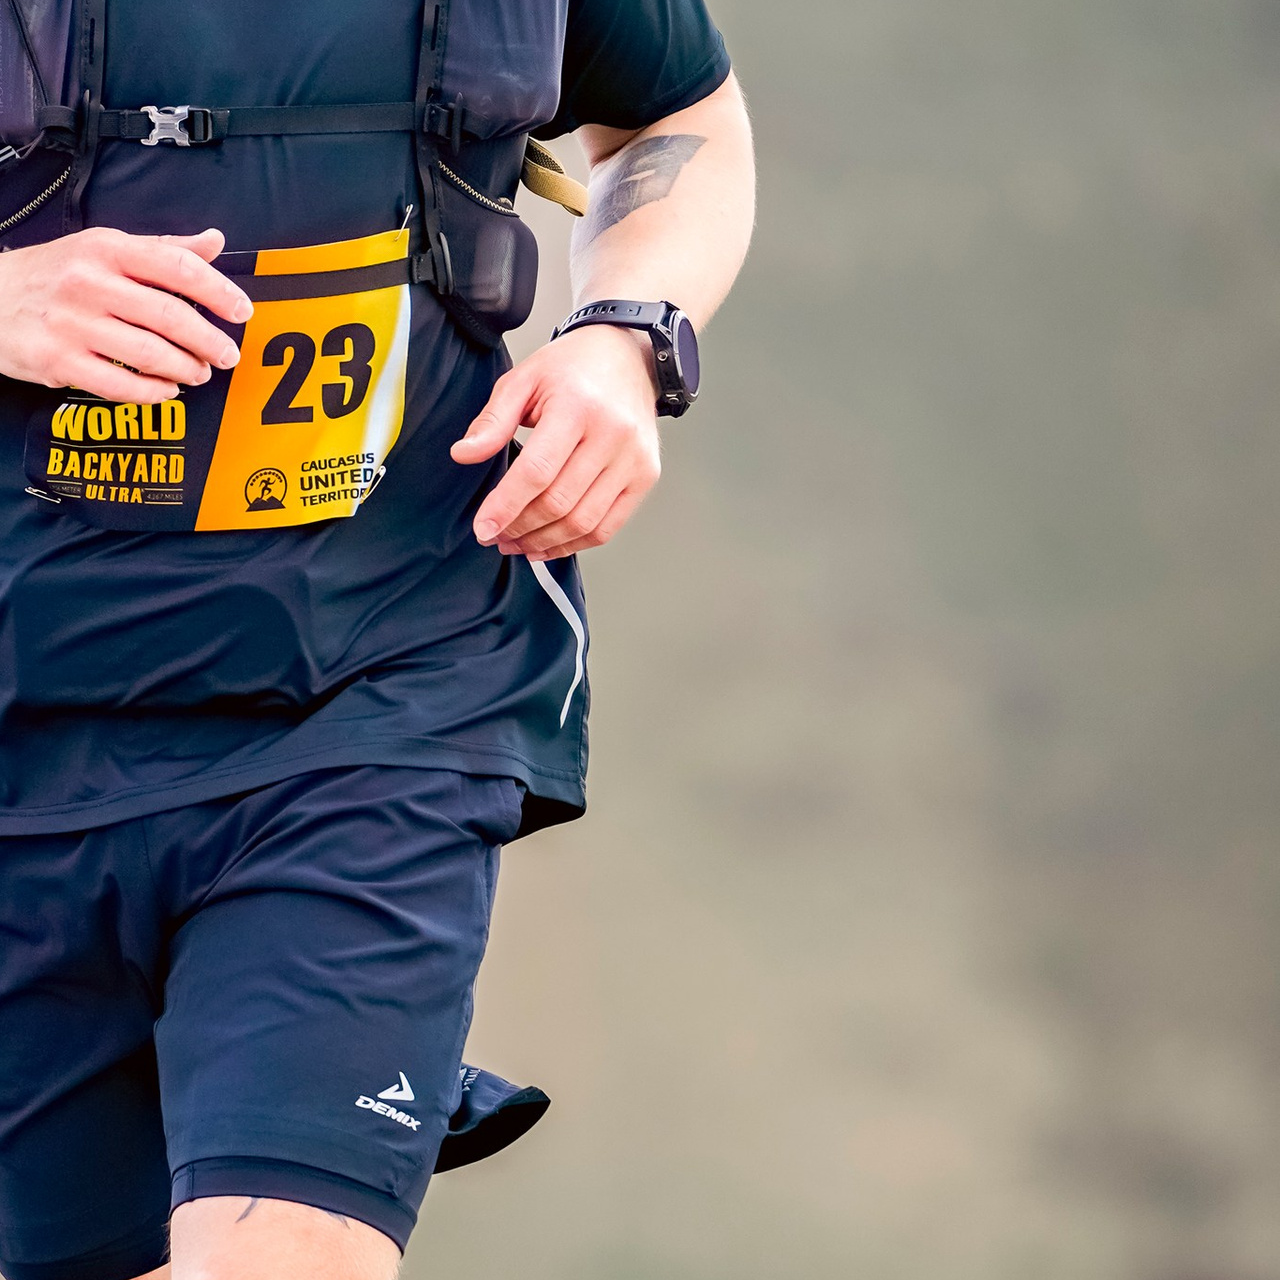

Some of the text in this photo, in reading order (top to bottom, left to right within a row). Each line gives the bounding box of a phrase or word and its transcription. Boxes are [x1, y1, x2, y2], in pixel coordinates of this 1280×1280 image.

[261, 322, 376, 425] 23
[51, 398, 186, 441] WORLD
[46, 448, 185, 484] BACKYARD
[300, 467, 374, 491] UNITED
[301, 452, 375, 472] CAUCASUS
[85, 484, 143, 504] ULTRA
[355, 1095, 421, 1132] DEMIX
